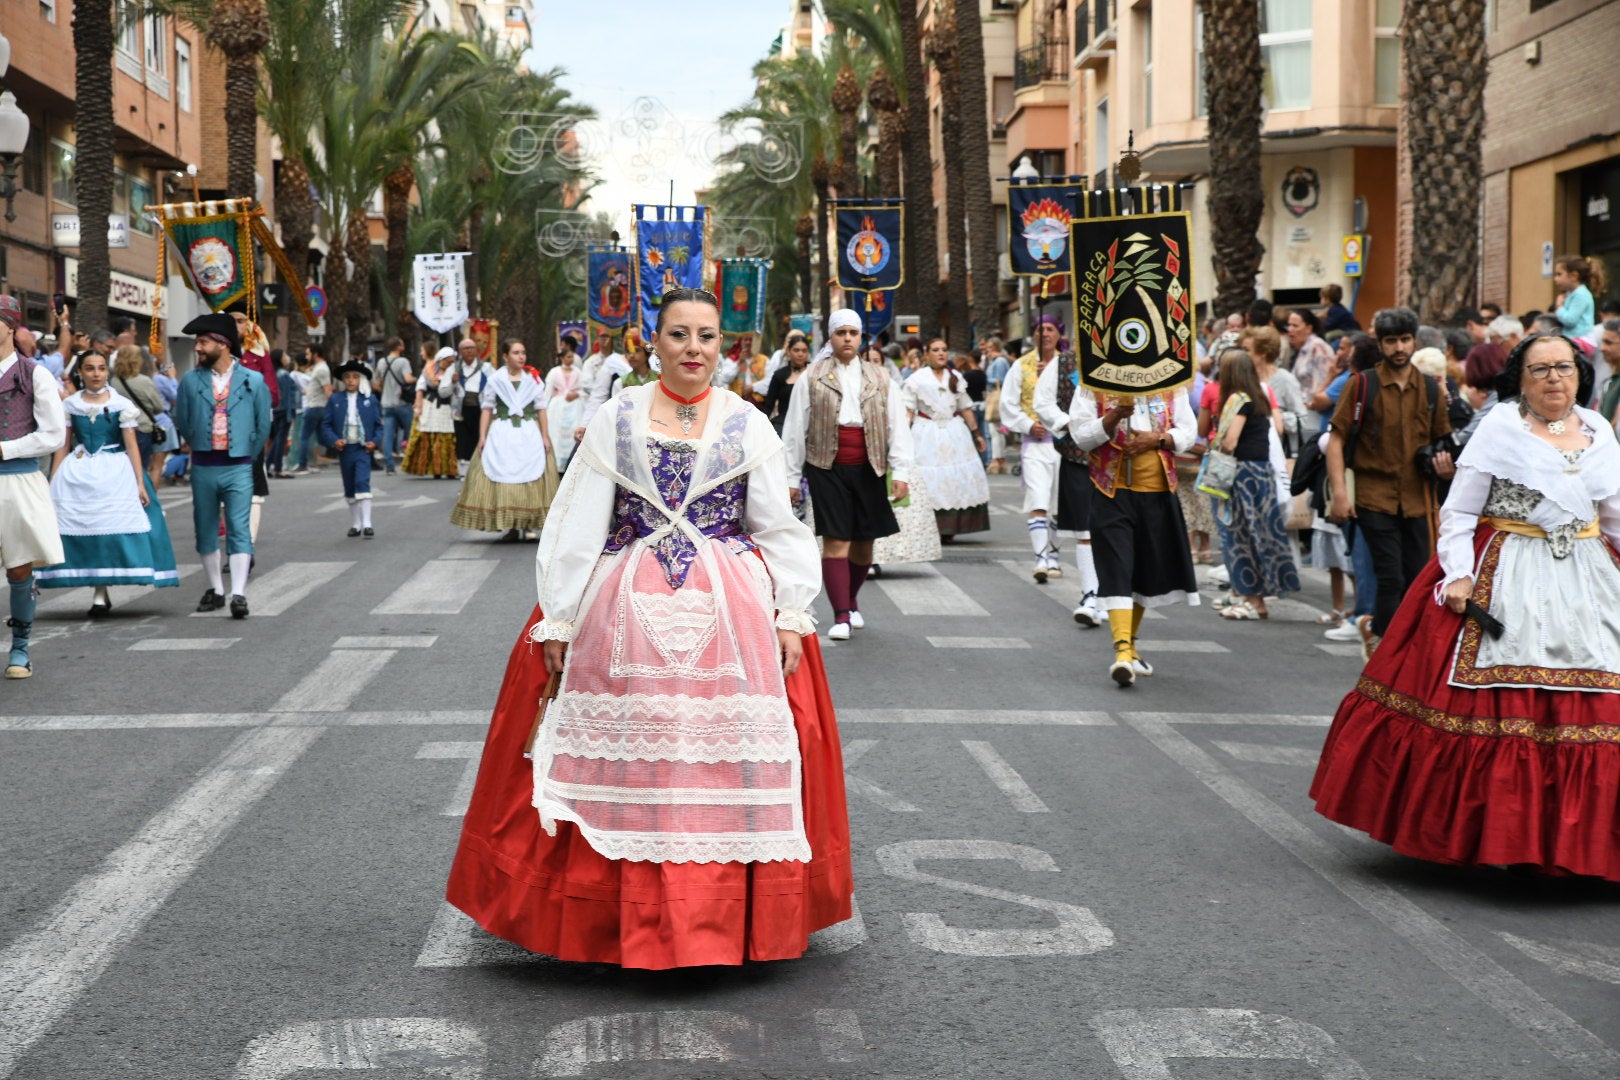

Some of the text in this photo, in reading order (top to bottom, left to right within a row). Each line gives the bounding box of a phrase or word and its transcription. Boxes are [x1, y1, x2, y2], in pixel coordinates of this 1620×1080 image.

[1080, 250, 1107, 335] BARRACA
[1096, 361, 1177, 385] DE L'HERCULES
